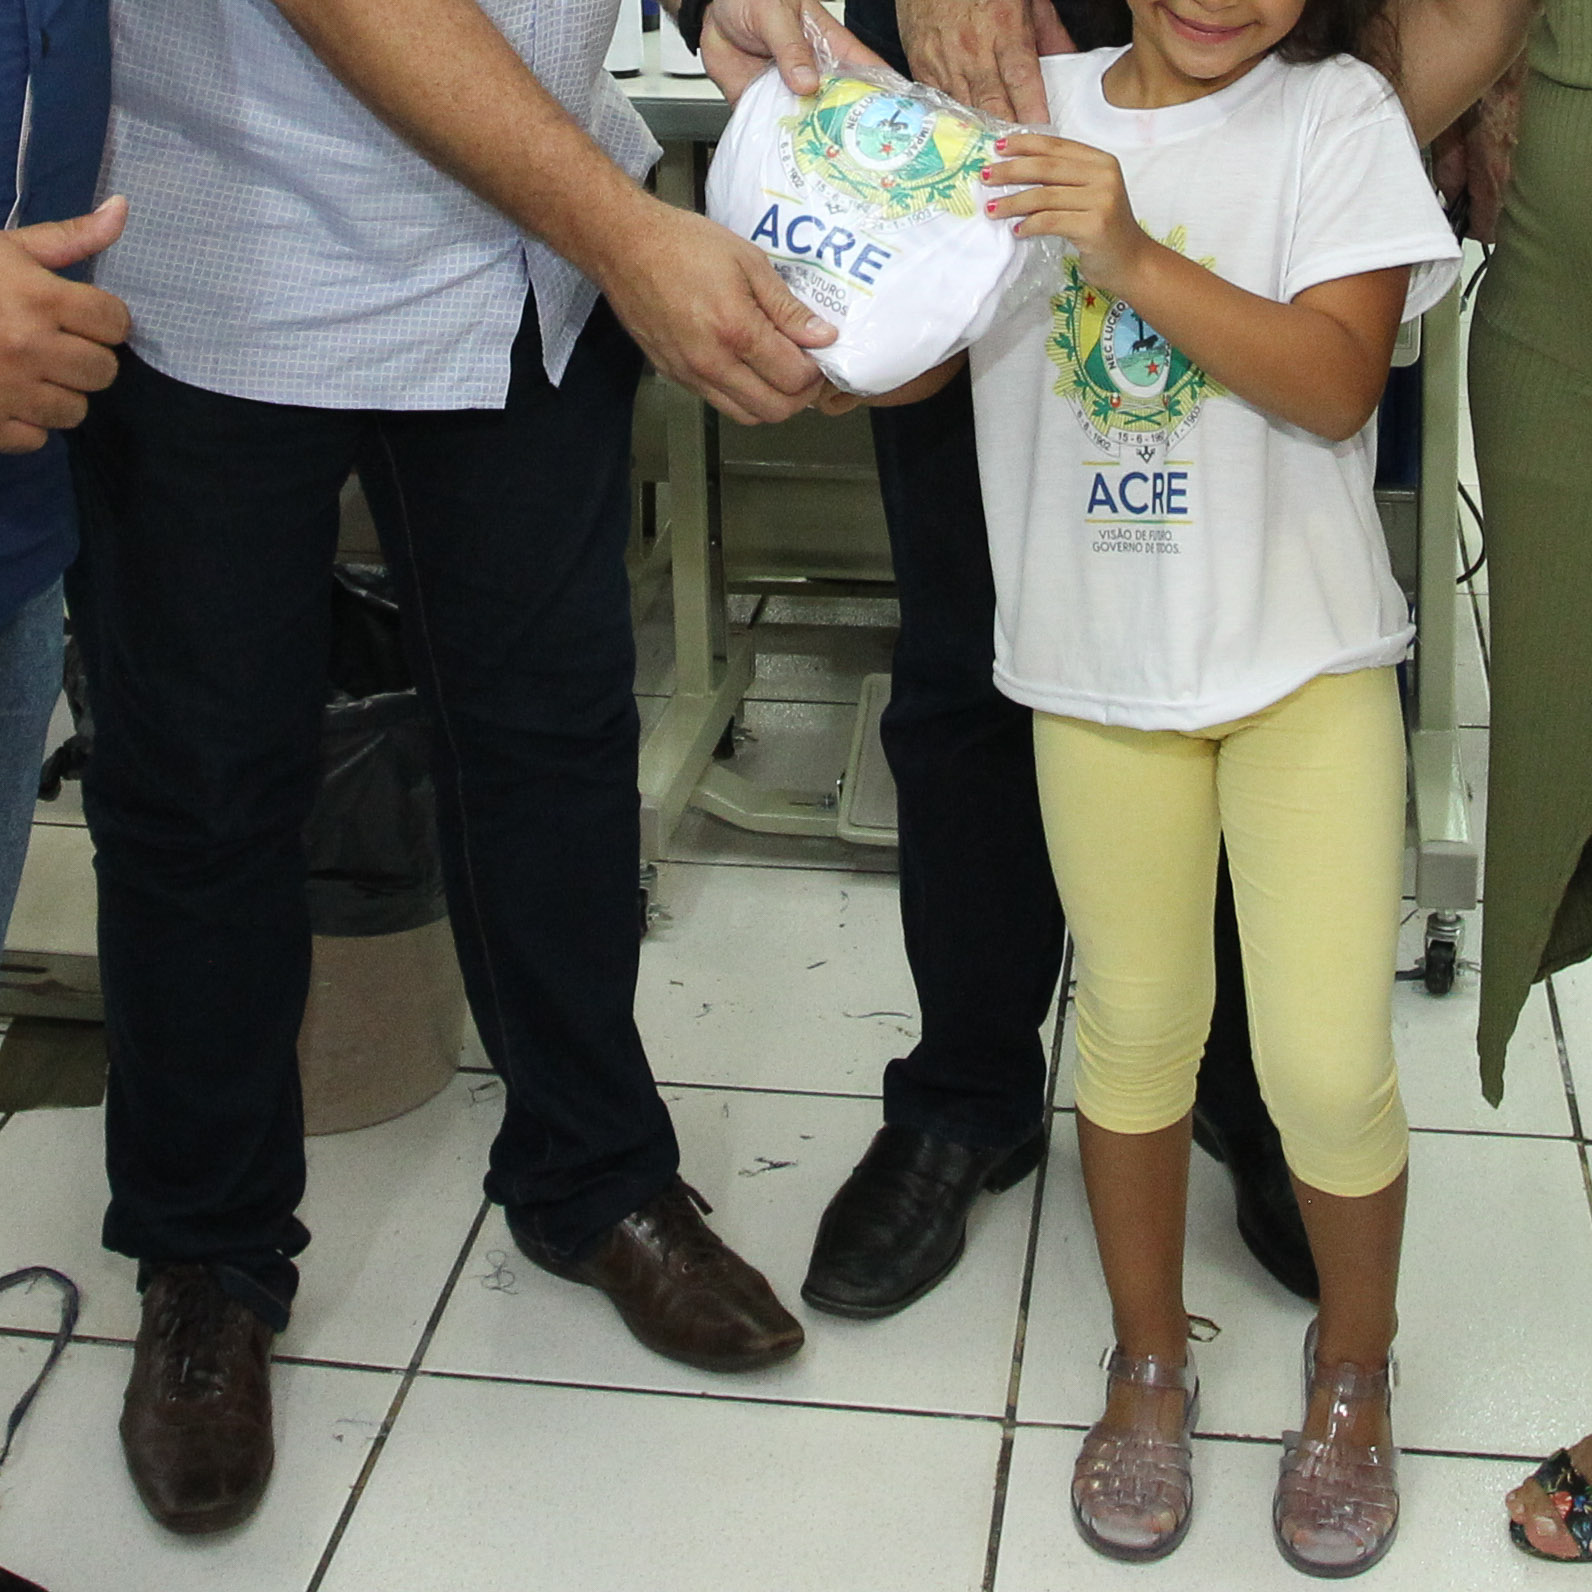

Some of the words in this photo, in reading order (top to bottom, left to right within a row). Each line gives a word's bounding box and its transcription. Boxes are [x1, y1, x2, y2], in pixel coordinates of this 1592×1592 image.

[845, 108, 862, 130] NEC
[750, 203, 892, 285] ACRE
[810, 273, 846, 300] UTURO
[1104, 301, 1126, 341] LUCEO
[1104, 345, 1117, 370] NEC
[1087, 471, 1188, 515] ACRE
[1098, 528, 1132, 541] VISÃO
[1135, 530, 1146, 541] DE
[1092, 542, 1143, 553] GOVERNO
[1145, 542, 1155, 554] DE
